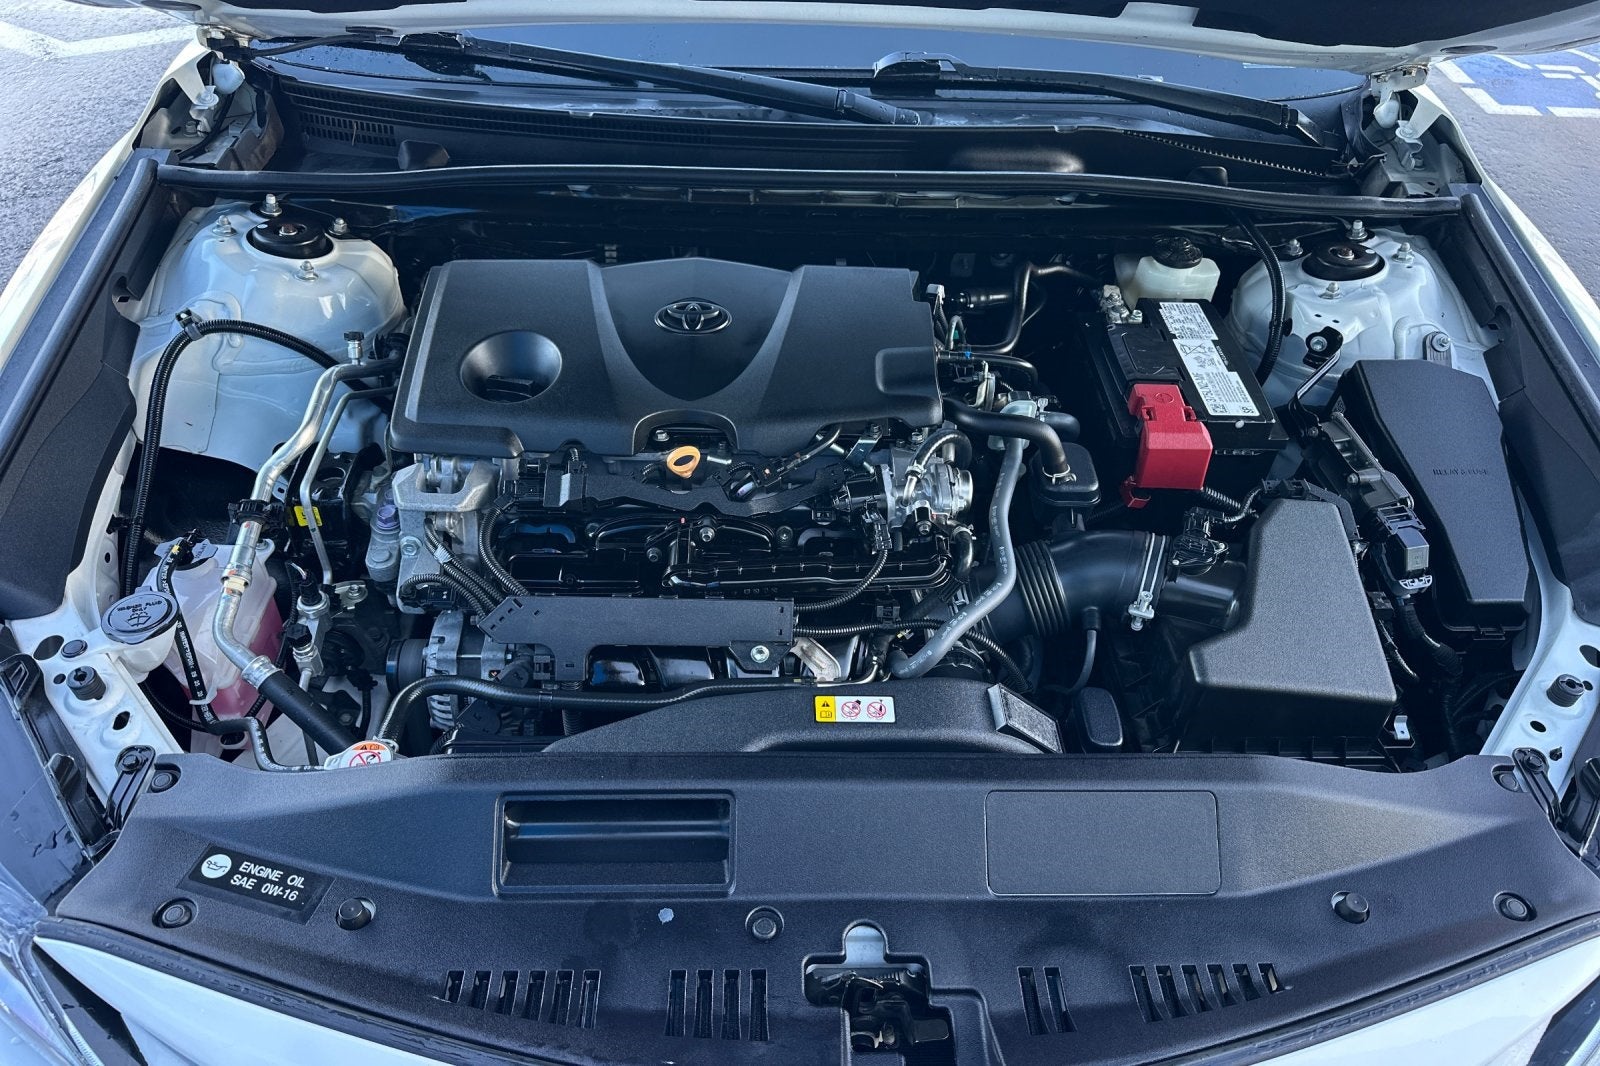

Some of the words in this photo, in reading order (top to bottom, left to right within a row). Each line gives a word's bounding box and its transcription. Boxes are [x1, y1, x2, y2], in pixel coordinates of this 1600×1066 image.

[230, 874, 257, 890] SAE
[261, 883, 299, 901] 0W-16
[239, 861, 284, 882] ENGINE
[286, 875, 306, 889] OIL
